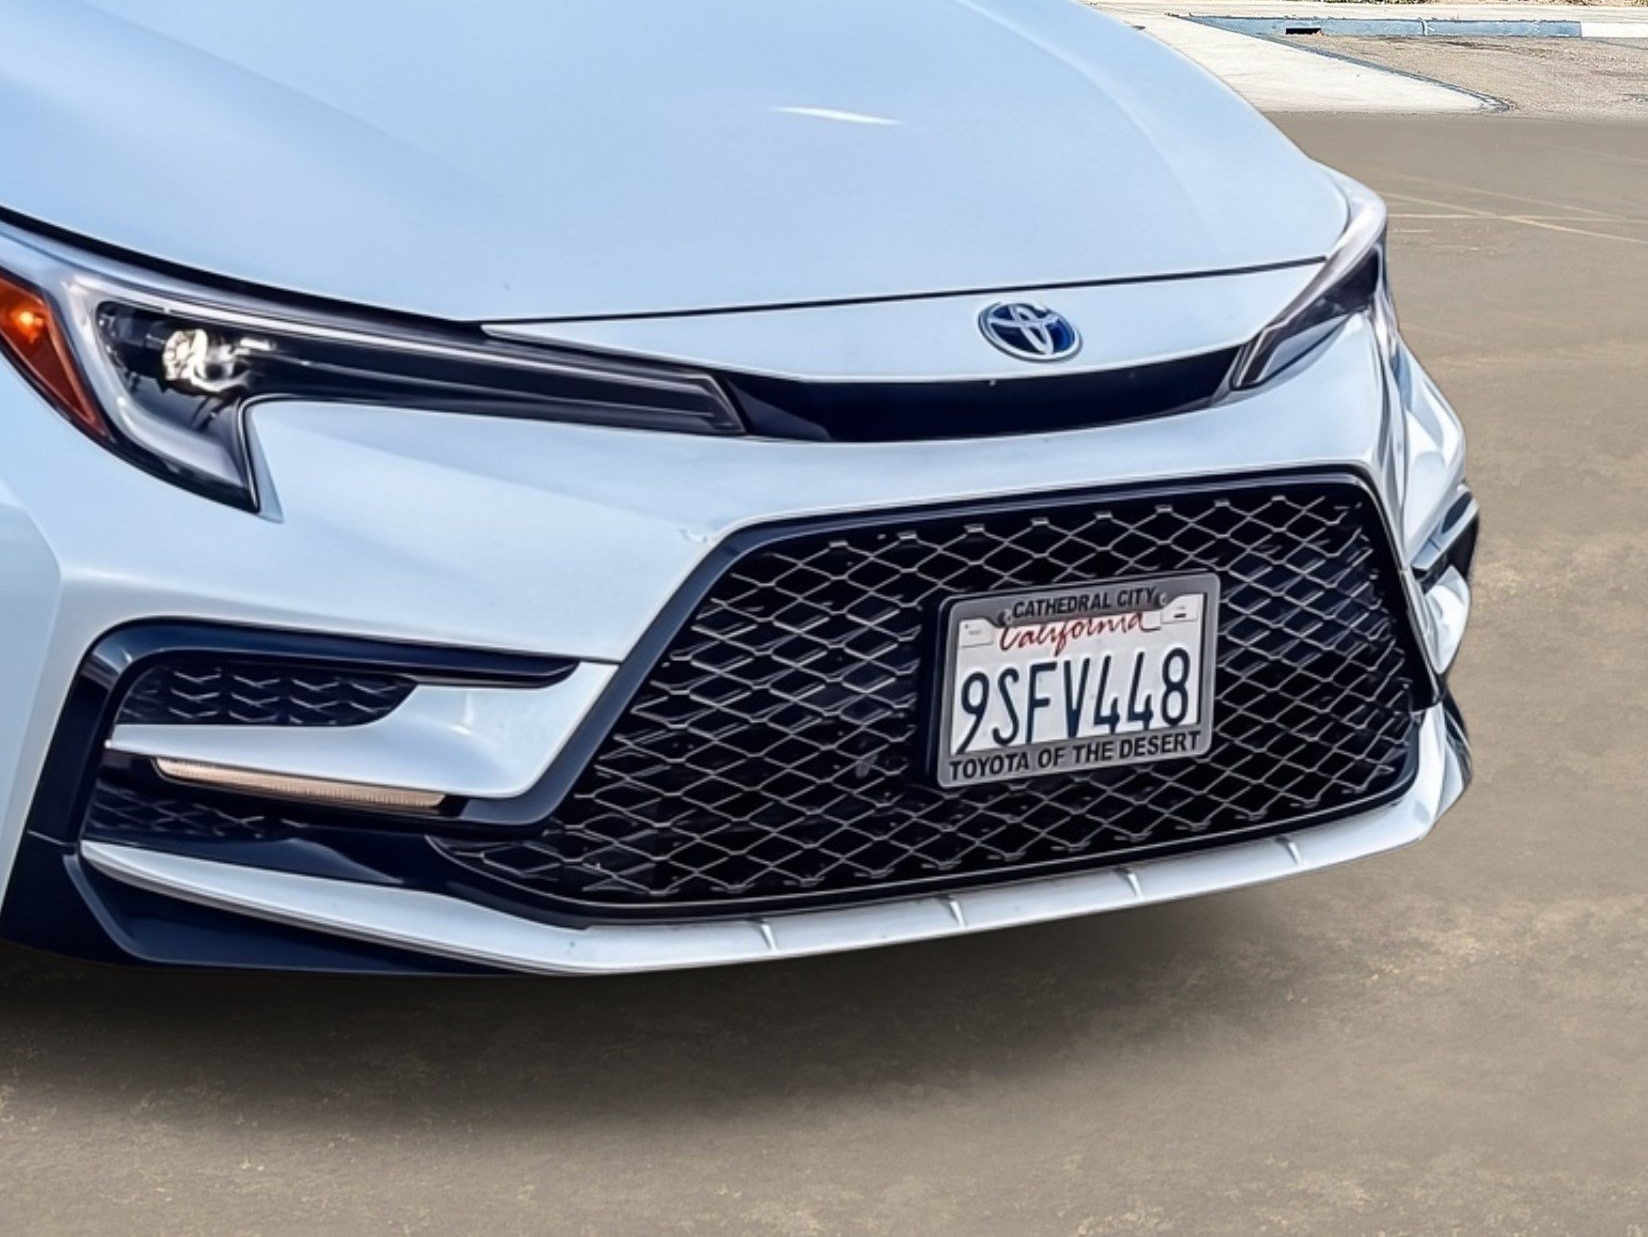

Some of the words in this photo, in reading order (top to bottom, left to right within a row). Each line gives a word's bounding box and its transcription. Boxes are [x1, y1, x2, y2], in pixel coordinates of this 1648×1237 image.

[1012, 593, 1111, 619] CATHEDRAL
[1117, 587, 1157, 607] CITY
[999, 612, 1162, 656] California
[954, 647, 1191, 755] 9SFV448
[951, 753, 1030, 780] TOYOTA
[1038, 748, 1065, 768] OF
[1072, 741, 1113, 763] THE
[1119, 731, 1201, 758] DESERT
